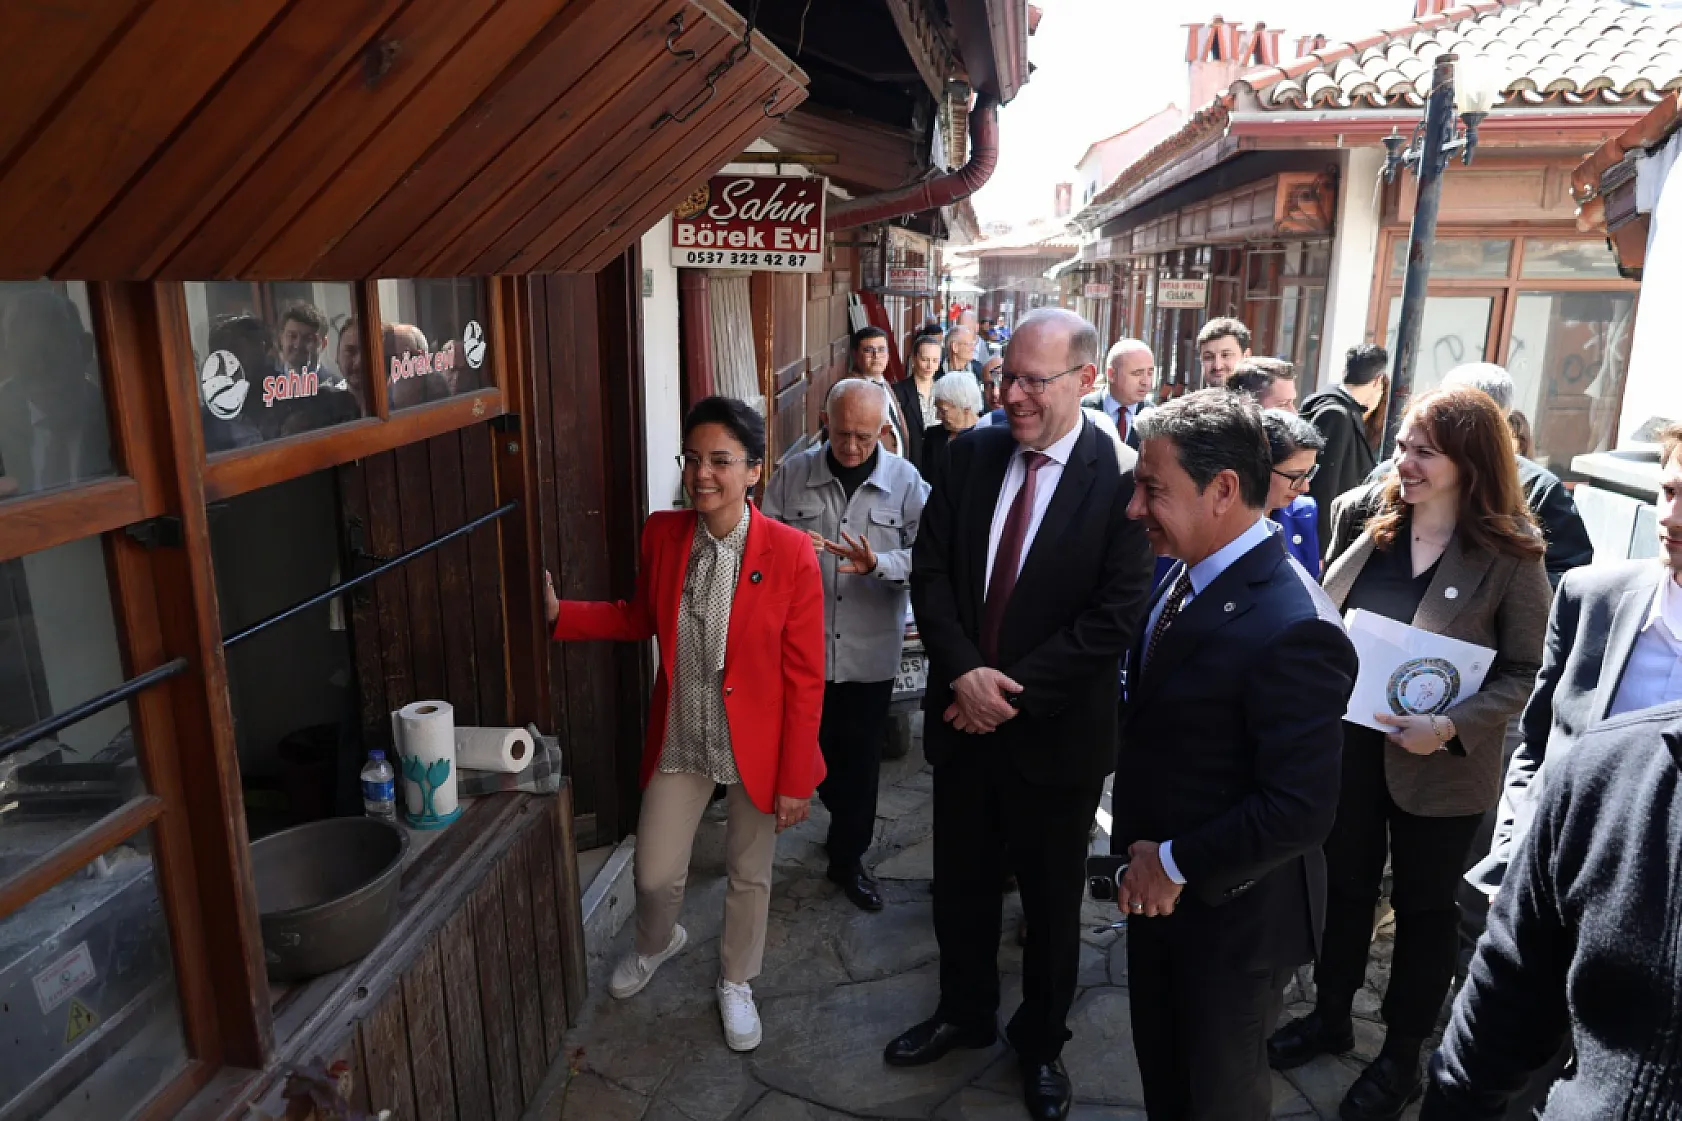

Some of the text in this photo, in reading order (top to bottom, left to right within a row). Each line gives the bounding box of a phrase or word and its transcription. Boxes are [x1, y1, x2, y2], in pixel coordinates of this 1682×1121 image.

[677, 223, 818, 250] Börek Evi
[687, 251, 807, 267] 0537 322 42 87
[263, 366, 318, 408] şahin
